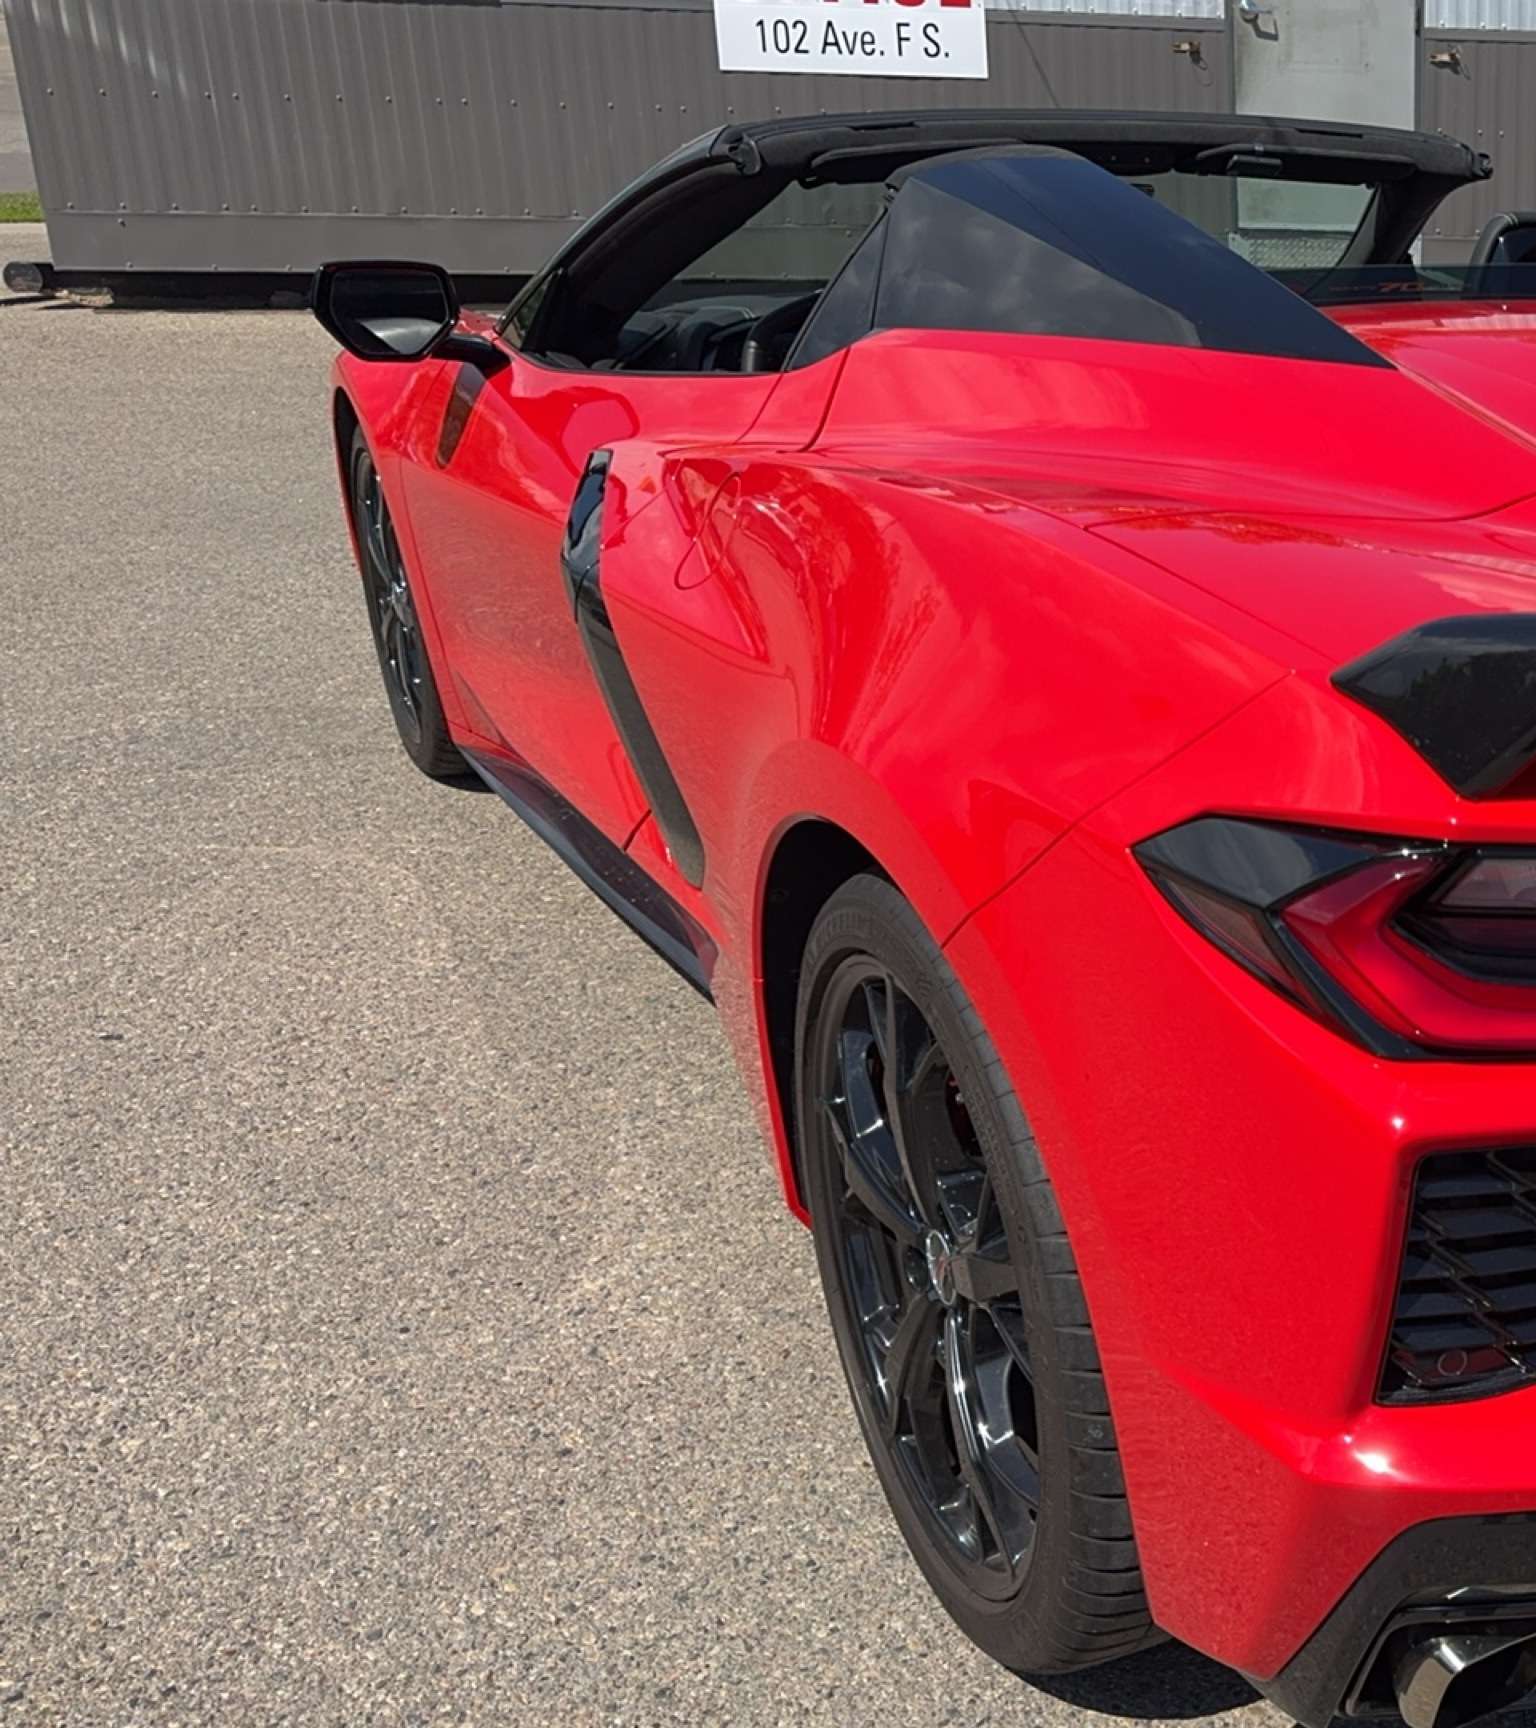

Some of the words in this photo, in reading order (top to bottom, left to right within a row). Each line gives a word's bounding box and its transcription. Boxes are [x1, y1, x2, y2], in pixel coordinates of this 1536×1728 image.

[756, 19, 809, 54] 102
[821, 20, 884, 57] Ave.
[896, 22, 912, 56] F
[922, 23, 950, 58] S.
